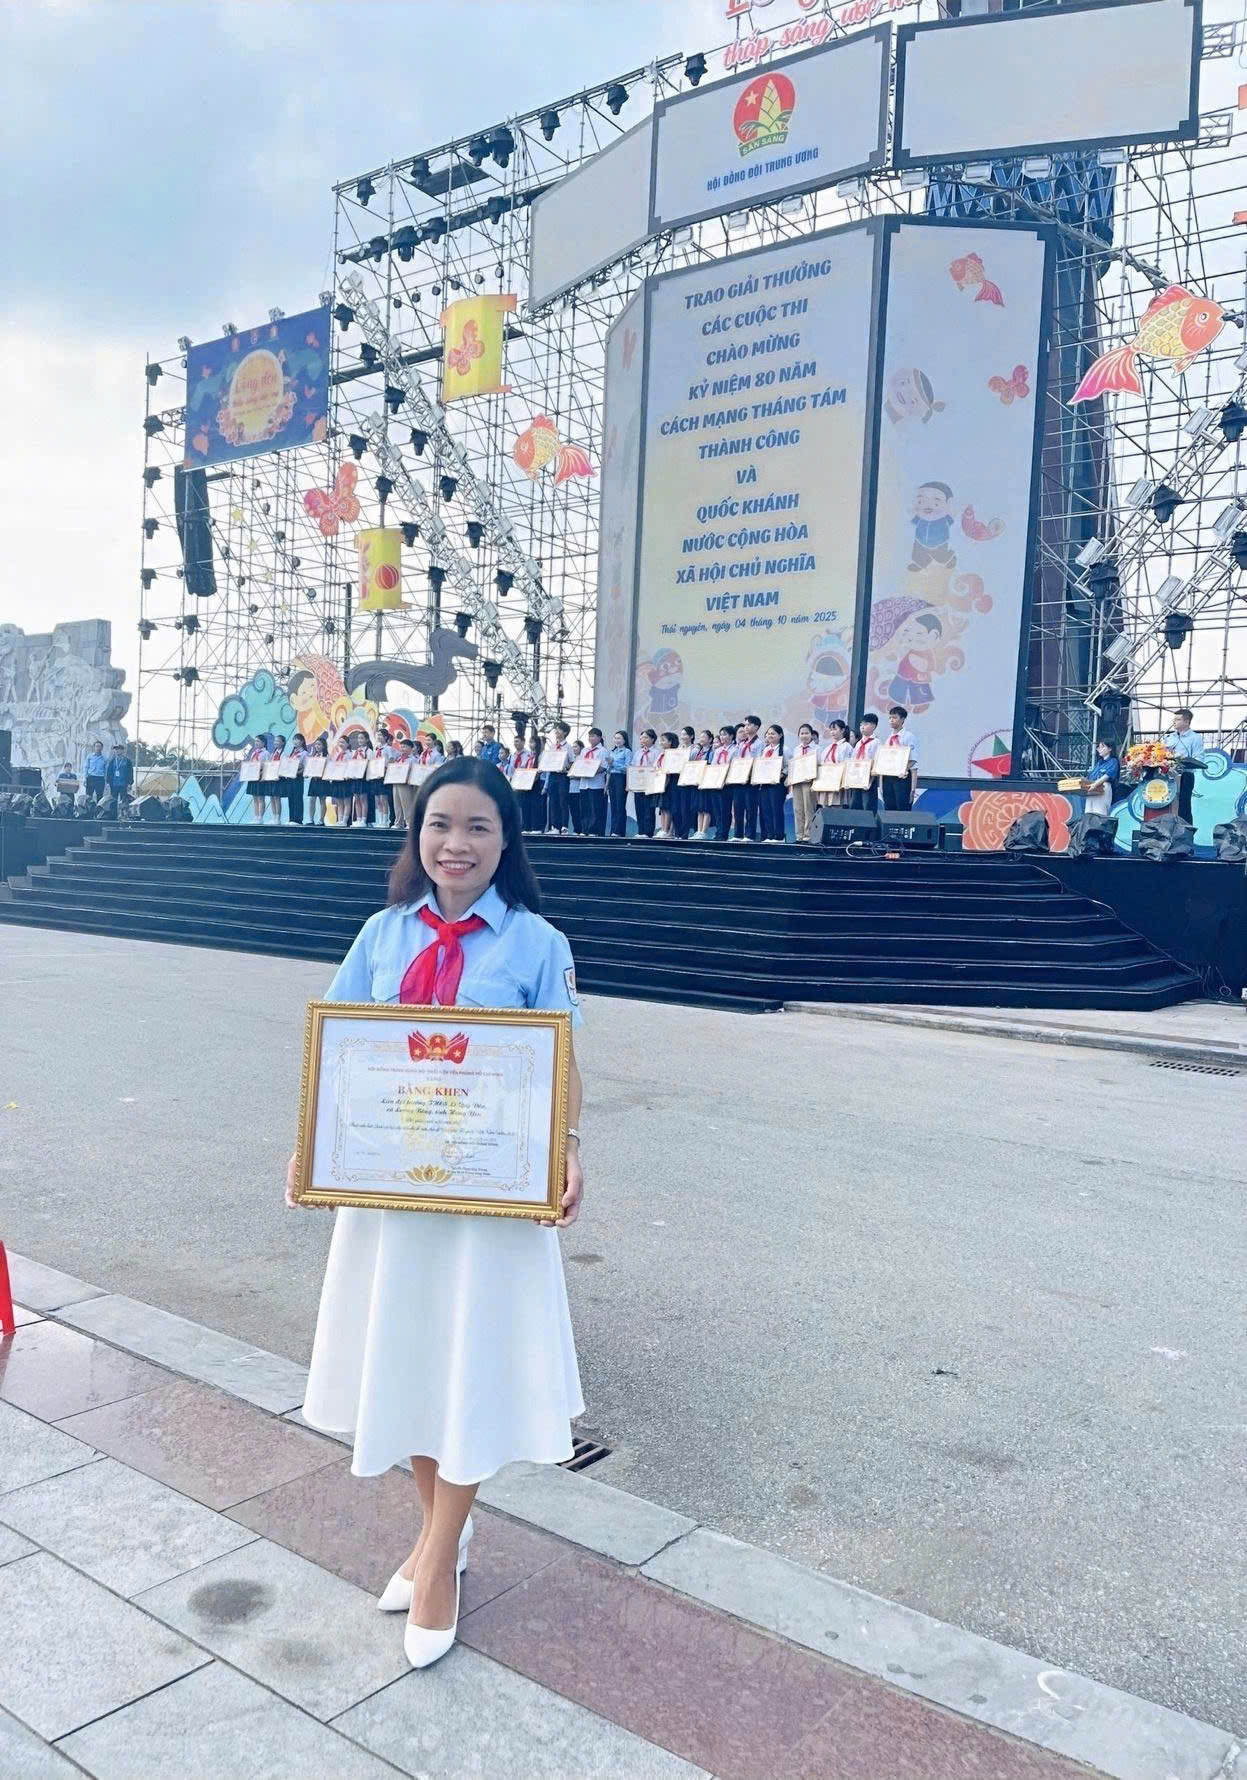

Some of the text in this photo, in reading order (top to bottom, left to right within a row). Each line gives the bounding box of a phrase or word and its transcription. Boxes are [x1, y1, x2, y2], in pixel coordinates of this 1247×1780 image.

[780, 17, 831, 46] sáng
[707, 147, 819, 192] HỘI ĐỒNG ĐỘI TRUNG ƯƠNG
[684, 258, 832, 310] TRAO GIẢI THƯỞNG
[702, 298, 809, 336] CÁC CUỘC THI
[706, 332, 801, 366] CHÀO MỪNG
[688, 361, 817, 401] KỶ NIỆM 80 NĂM
[660, 386, 847, 436] CÁCH MẠNG THÁNG TÁM
[698, 429, 801, 460] THÀNH CÔNG
[736, 465, 758, 485] VÀ
[696, 493, 800, 524] QUỐC KHÁNH
[682, 521, 809, 553] NƯỚC CỘNG HÒA
[676, 552, 816, 586] XÃ HỘI CHỦ NGHĨA
[706, 591, 780, 613] VIỆT NAM
[712, 620, 731, 633] ngày
[735, 618, 746, 629] 04
[750, 616, 773, 630] tháng
[777, 614, 787, 625] 10
[790, 614, 810, 624] năm
[814, 610, 837, 622] 2025
[435, 1087, 470, 1097] KHEN
